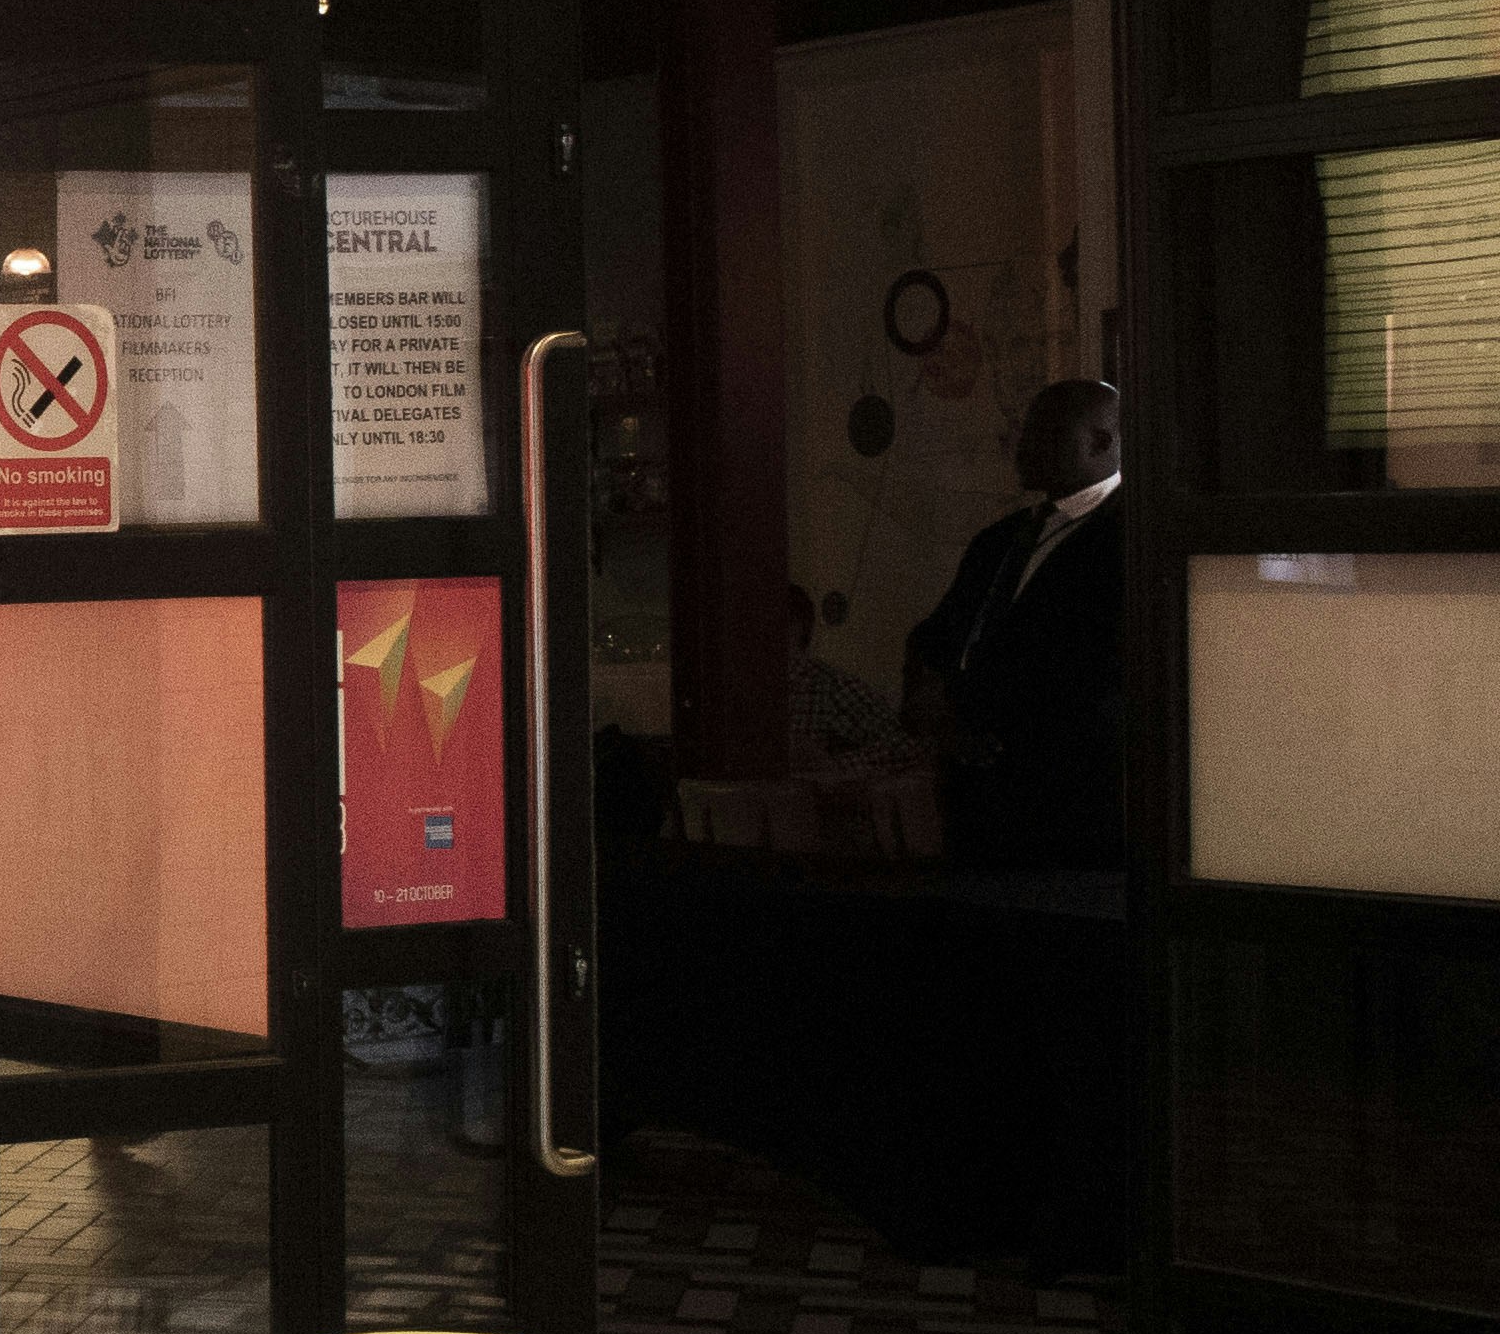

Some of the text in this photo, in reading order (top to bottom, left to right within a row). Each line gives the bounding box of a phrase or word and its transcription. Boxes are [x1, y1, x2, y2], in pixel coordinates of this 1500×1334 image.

[327, 209, 438, 227] ICTUREHOUSE
[145, 224, 168, 236] THE
[144, 236, 203, 249] NATIONAL
[144, 248, 200, 261] LOTTERY
[155, 287, 177, 302] BFI
[398, 291, 429, 305] BAR
[432, 290, 466, 305] WILL
[113, 314, 232, 329] ATIONAL LOTTERY
[329, 314, 462, 329] LOSED UNTIL 15:00
[121, 341, 212, 355] FILMMAKERS
[351, 338, 382, 353] FOR
[385, 338, 397, 352] A
[399, 337, 460, 352] PRIVATE
[348, 361, 361, 375] IT
[364, 361, 400, 376] WILL
[403, 360, 442, 374] THEN
[445, 359, 466, 374] BE
[128, 368, 205, 383] RECEPTION
[343, 382, 466, 399] TO LONDON FILM
[373, 406, 462, 421] DELEGATES
[332, 429, 446, 446] NLY UNTIL 18:30
[27, 466, 105, 486] smoking
[22, 497, 55, 509] against
[56, 497, 70, 506] the
[72, 497, 88, 506] law
[89, 496, 98, 506] to
[27, 508, 37, 518] in
[409, 883, 454, 902] OCTOBER
